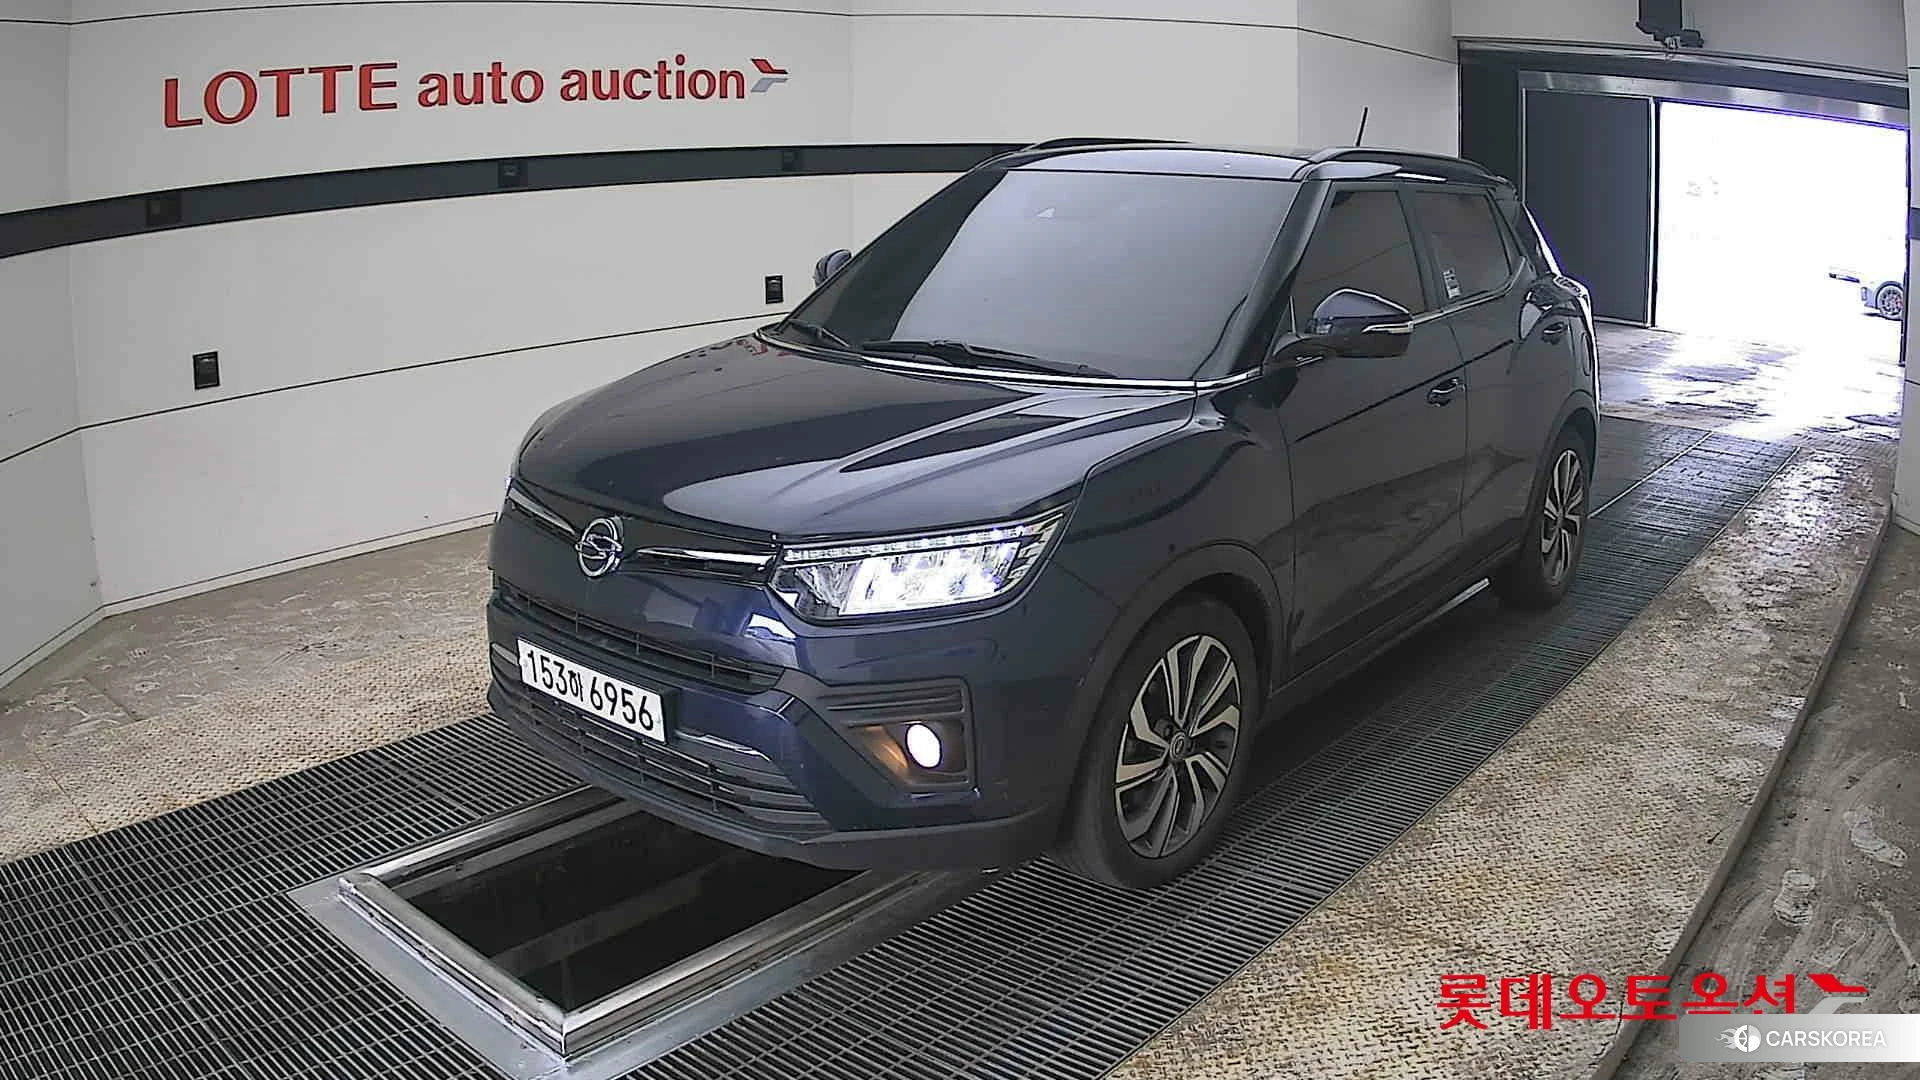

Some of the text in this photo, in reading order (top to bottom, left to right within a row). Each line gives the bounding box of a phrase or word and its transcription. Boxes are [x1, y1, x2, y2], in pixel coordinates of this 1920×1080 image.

[163, 54, 746, 128] LOTTE auto auction
[590, 676, 654, 732] 6956
